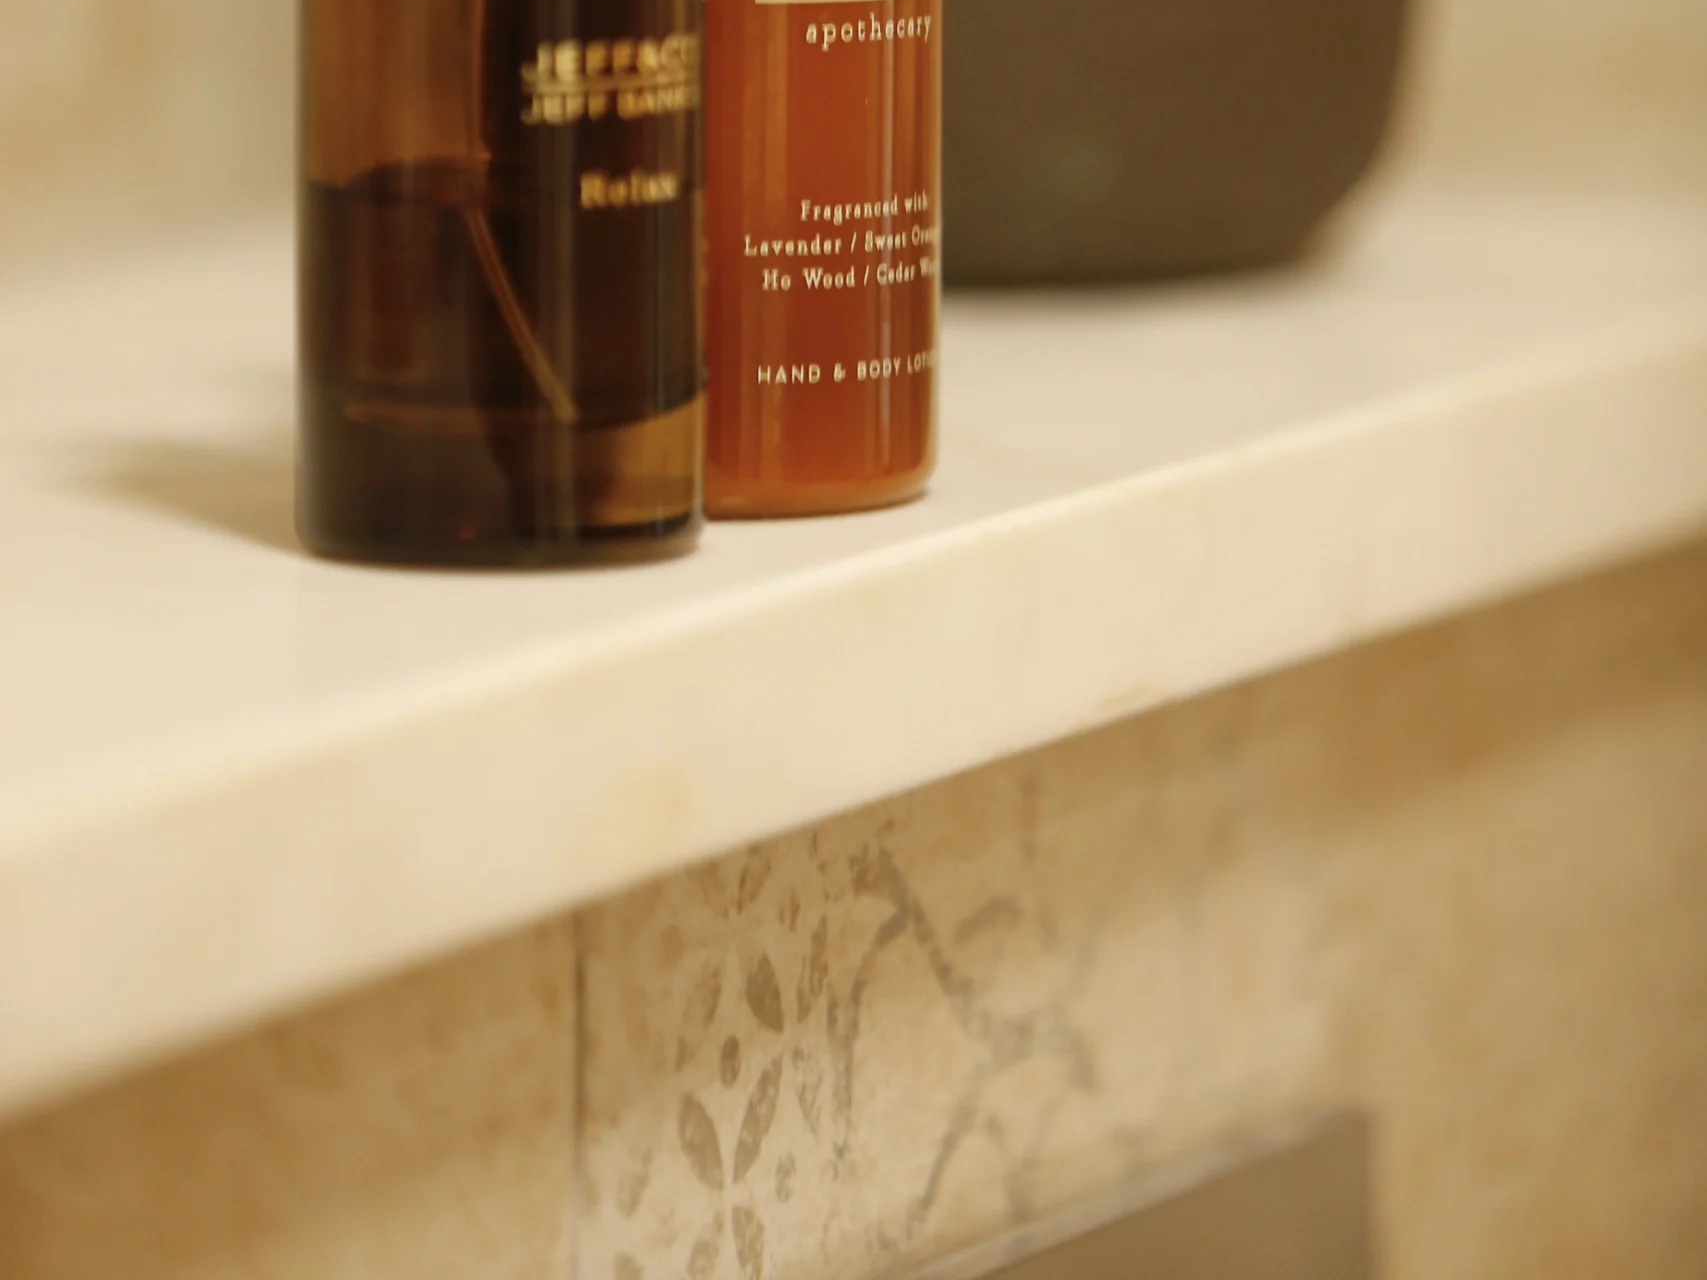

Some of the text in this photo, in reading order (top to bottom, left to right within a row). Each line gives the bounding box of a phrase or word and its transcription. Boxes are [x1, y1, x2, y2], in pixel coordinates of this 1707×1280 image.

[806, 12, 932, 52] apothecary
[801, 190, 929, 226] Fragranced with
[744, 233, 842, 257] Lavender
[864, 230, 908, 253] Sweet
[762, 268, 792, 291] Ho
[802, 266, 855, 290] Wood
[876, 261, 916, 286] Cedar
[757, 364, 822, 385] HAND
[833, 362, 846, 383] &
[856, 356, 901, 382] BODY
